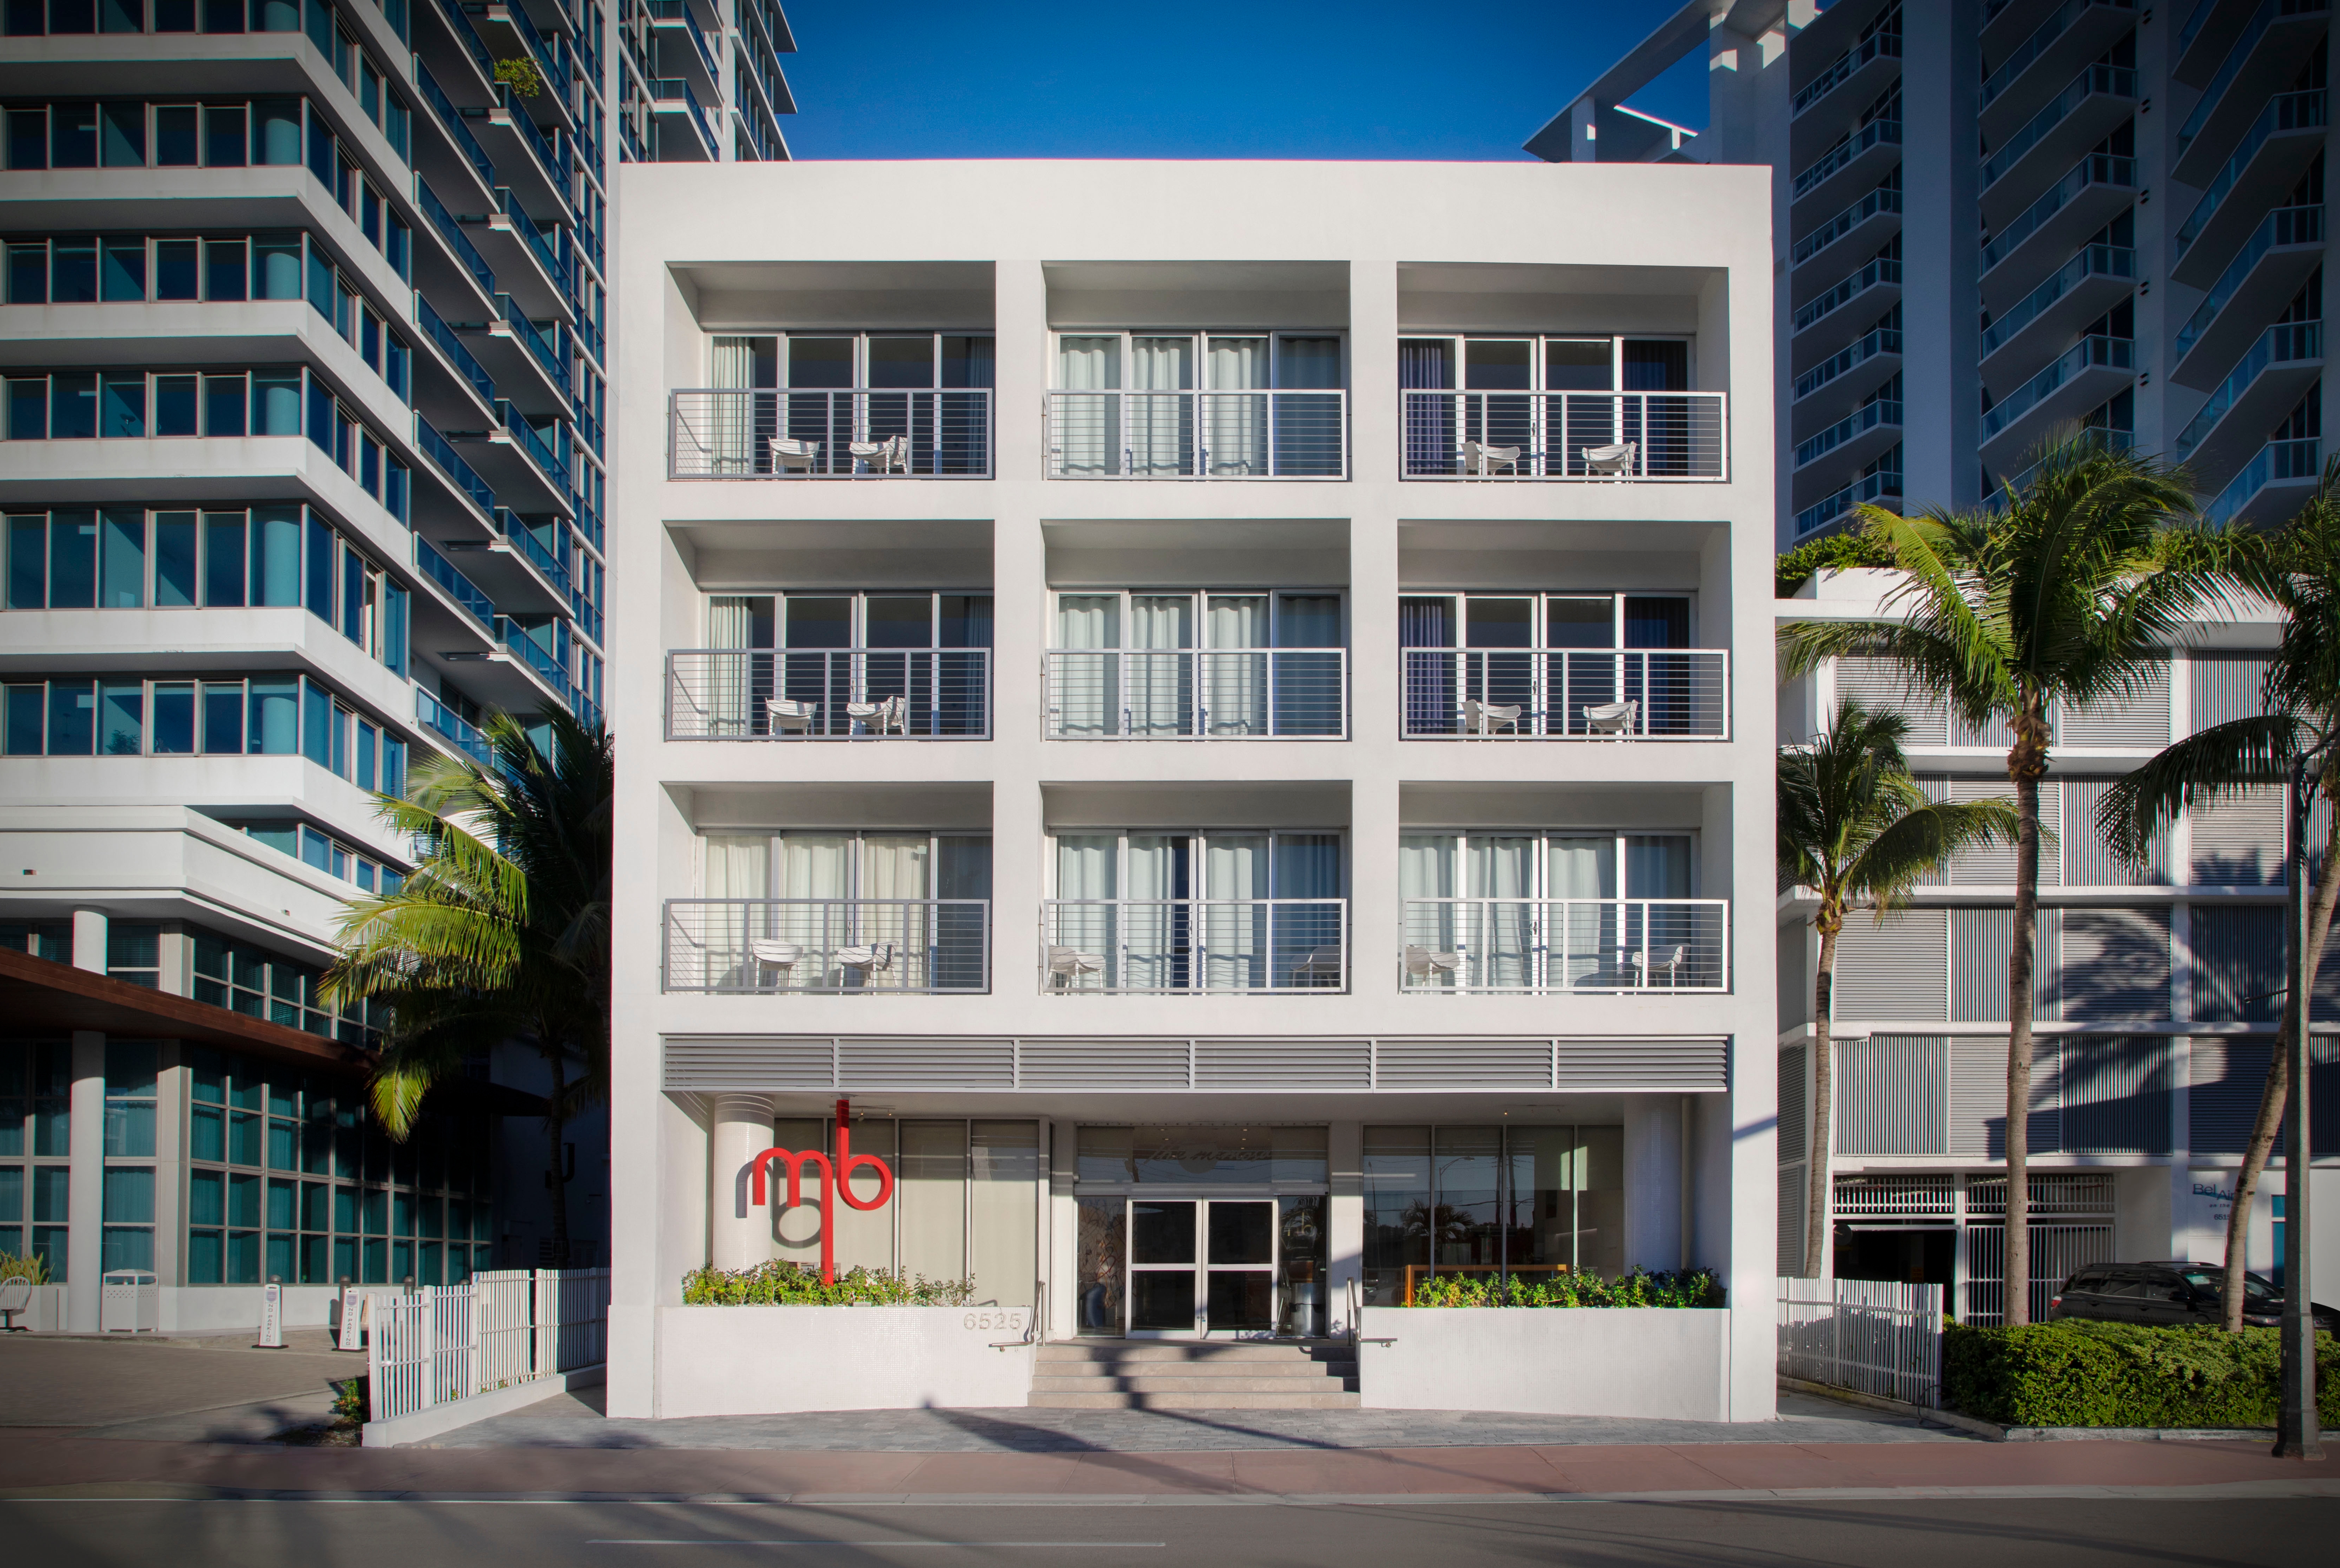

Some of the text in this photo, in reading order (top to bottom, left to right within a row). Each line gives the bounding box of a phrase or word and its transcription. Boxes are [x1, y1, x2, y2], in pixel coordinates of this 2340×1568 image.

[2193, 1184, 2215, 1195] Bel
[268, 1304, 273, 1312] NO
[963, 1312, 1022, 1330] 6525
